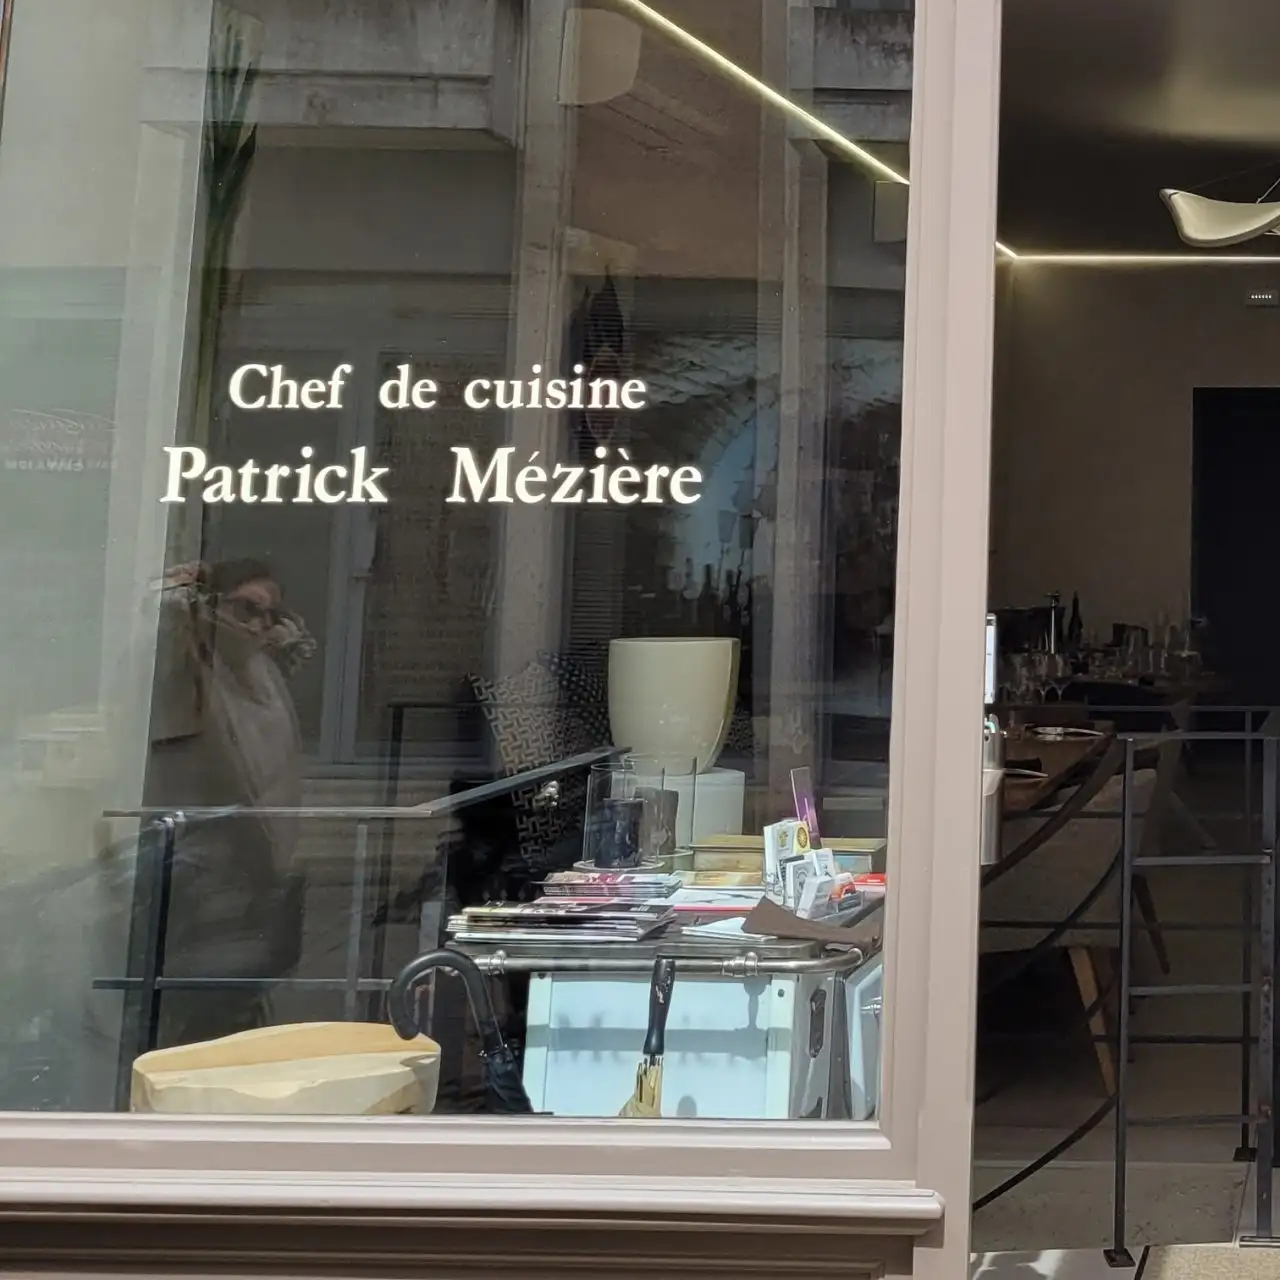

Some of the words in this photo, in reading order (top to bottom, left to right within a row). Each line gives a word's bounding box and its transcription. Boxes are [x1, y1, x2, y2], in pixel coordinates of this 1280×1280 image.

[229, 363, 352, 409] Chef
[379, 363, 437, 409] de
[464, 363, 646, 409] cuisine
[159, 445, 389, 504] Patrick
[445, 446, 703, 504] Mézière
